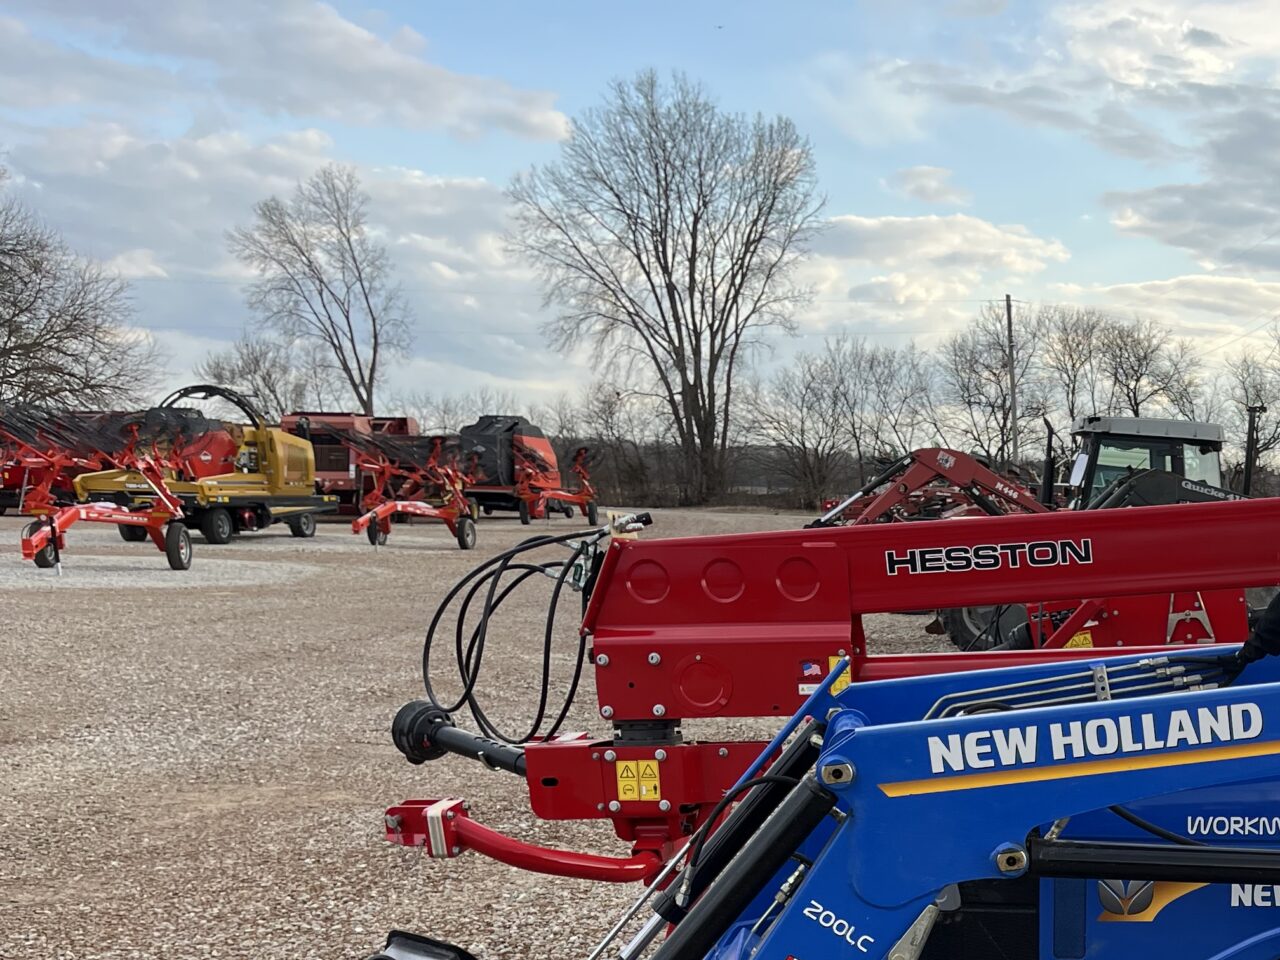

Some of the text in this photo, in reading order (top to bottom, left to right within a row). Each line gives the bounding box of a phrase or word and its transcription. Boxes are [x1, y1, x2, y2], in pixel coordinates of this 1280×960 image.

[885, 538, 1093, 576] HESSTON
[927, 703, 1263, 774] NEW HOLLAND
[803, 900, 875, 953] 200LC
